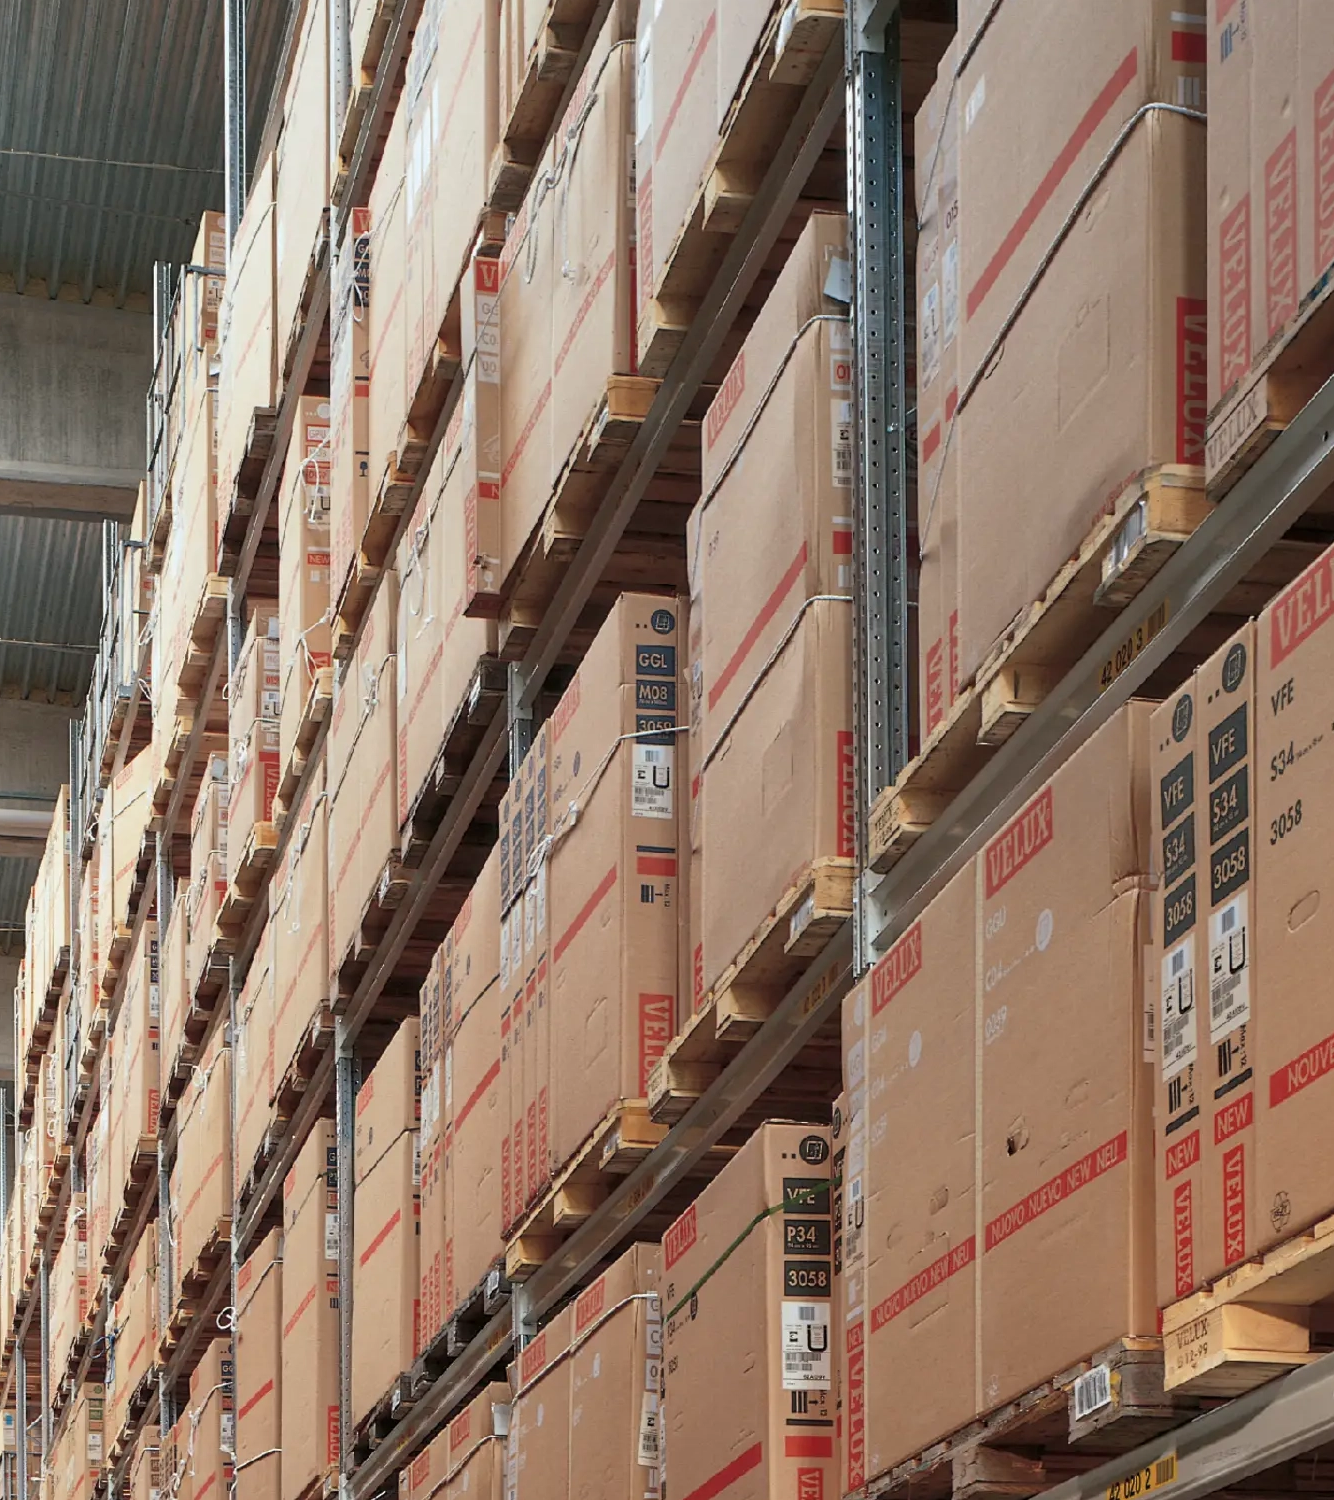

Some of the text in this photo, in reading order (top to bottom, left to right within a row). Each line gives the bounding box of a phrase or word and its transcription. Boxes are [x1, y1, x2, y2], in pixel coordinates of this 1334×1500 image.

[639, 653, 667, 668] GGL
[639, 685, 667, 700] M08
[1271, 678, 1294, 716] VFE
[1211, 728, 1236, 766] VFE
[1271, 741, 1295, 781] S34
[1164, 776, 1184, 810] VFE
[1212, 783, 1238, 824] S34
[1270, 799, 1302, 845] 3058
[989, 803, 1049, 885] VELUX
[1213, 845, 1245, 890] 3058
[1166, 891, 1193, 932] 3058
[873, 936, 920, 1007] VELUX
[1217, 1100, 1249, 1139] NEW
[1168, 1136, 1196, 1174] NEW
[991, 1144, 1117, 1244] NUOVO NUEVO NEW NEU
[1226, 1150, 1243, 1258] VELUX
[787, 1226, 816, 1242] P34
[1176, 1187, 1192, 1290] VELUX
[788, 1270, 827, 1287] 3058
[1176, 1317, 1209, 1350] VELUX
[1123, 1475, 1141, 1498] 020
[1144, 1468, 1151, 1490] 2
